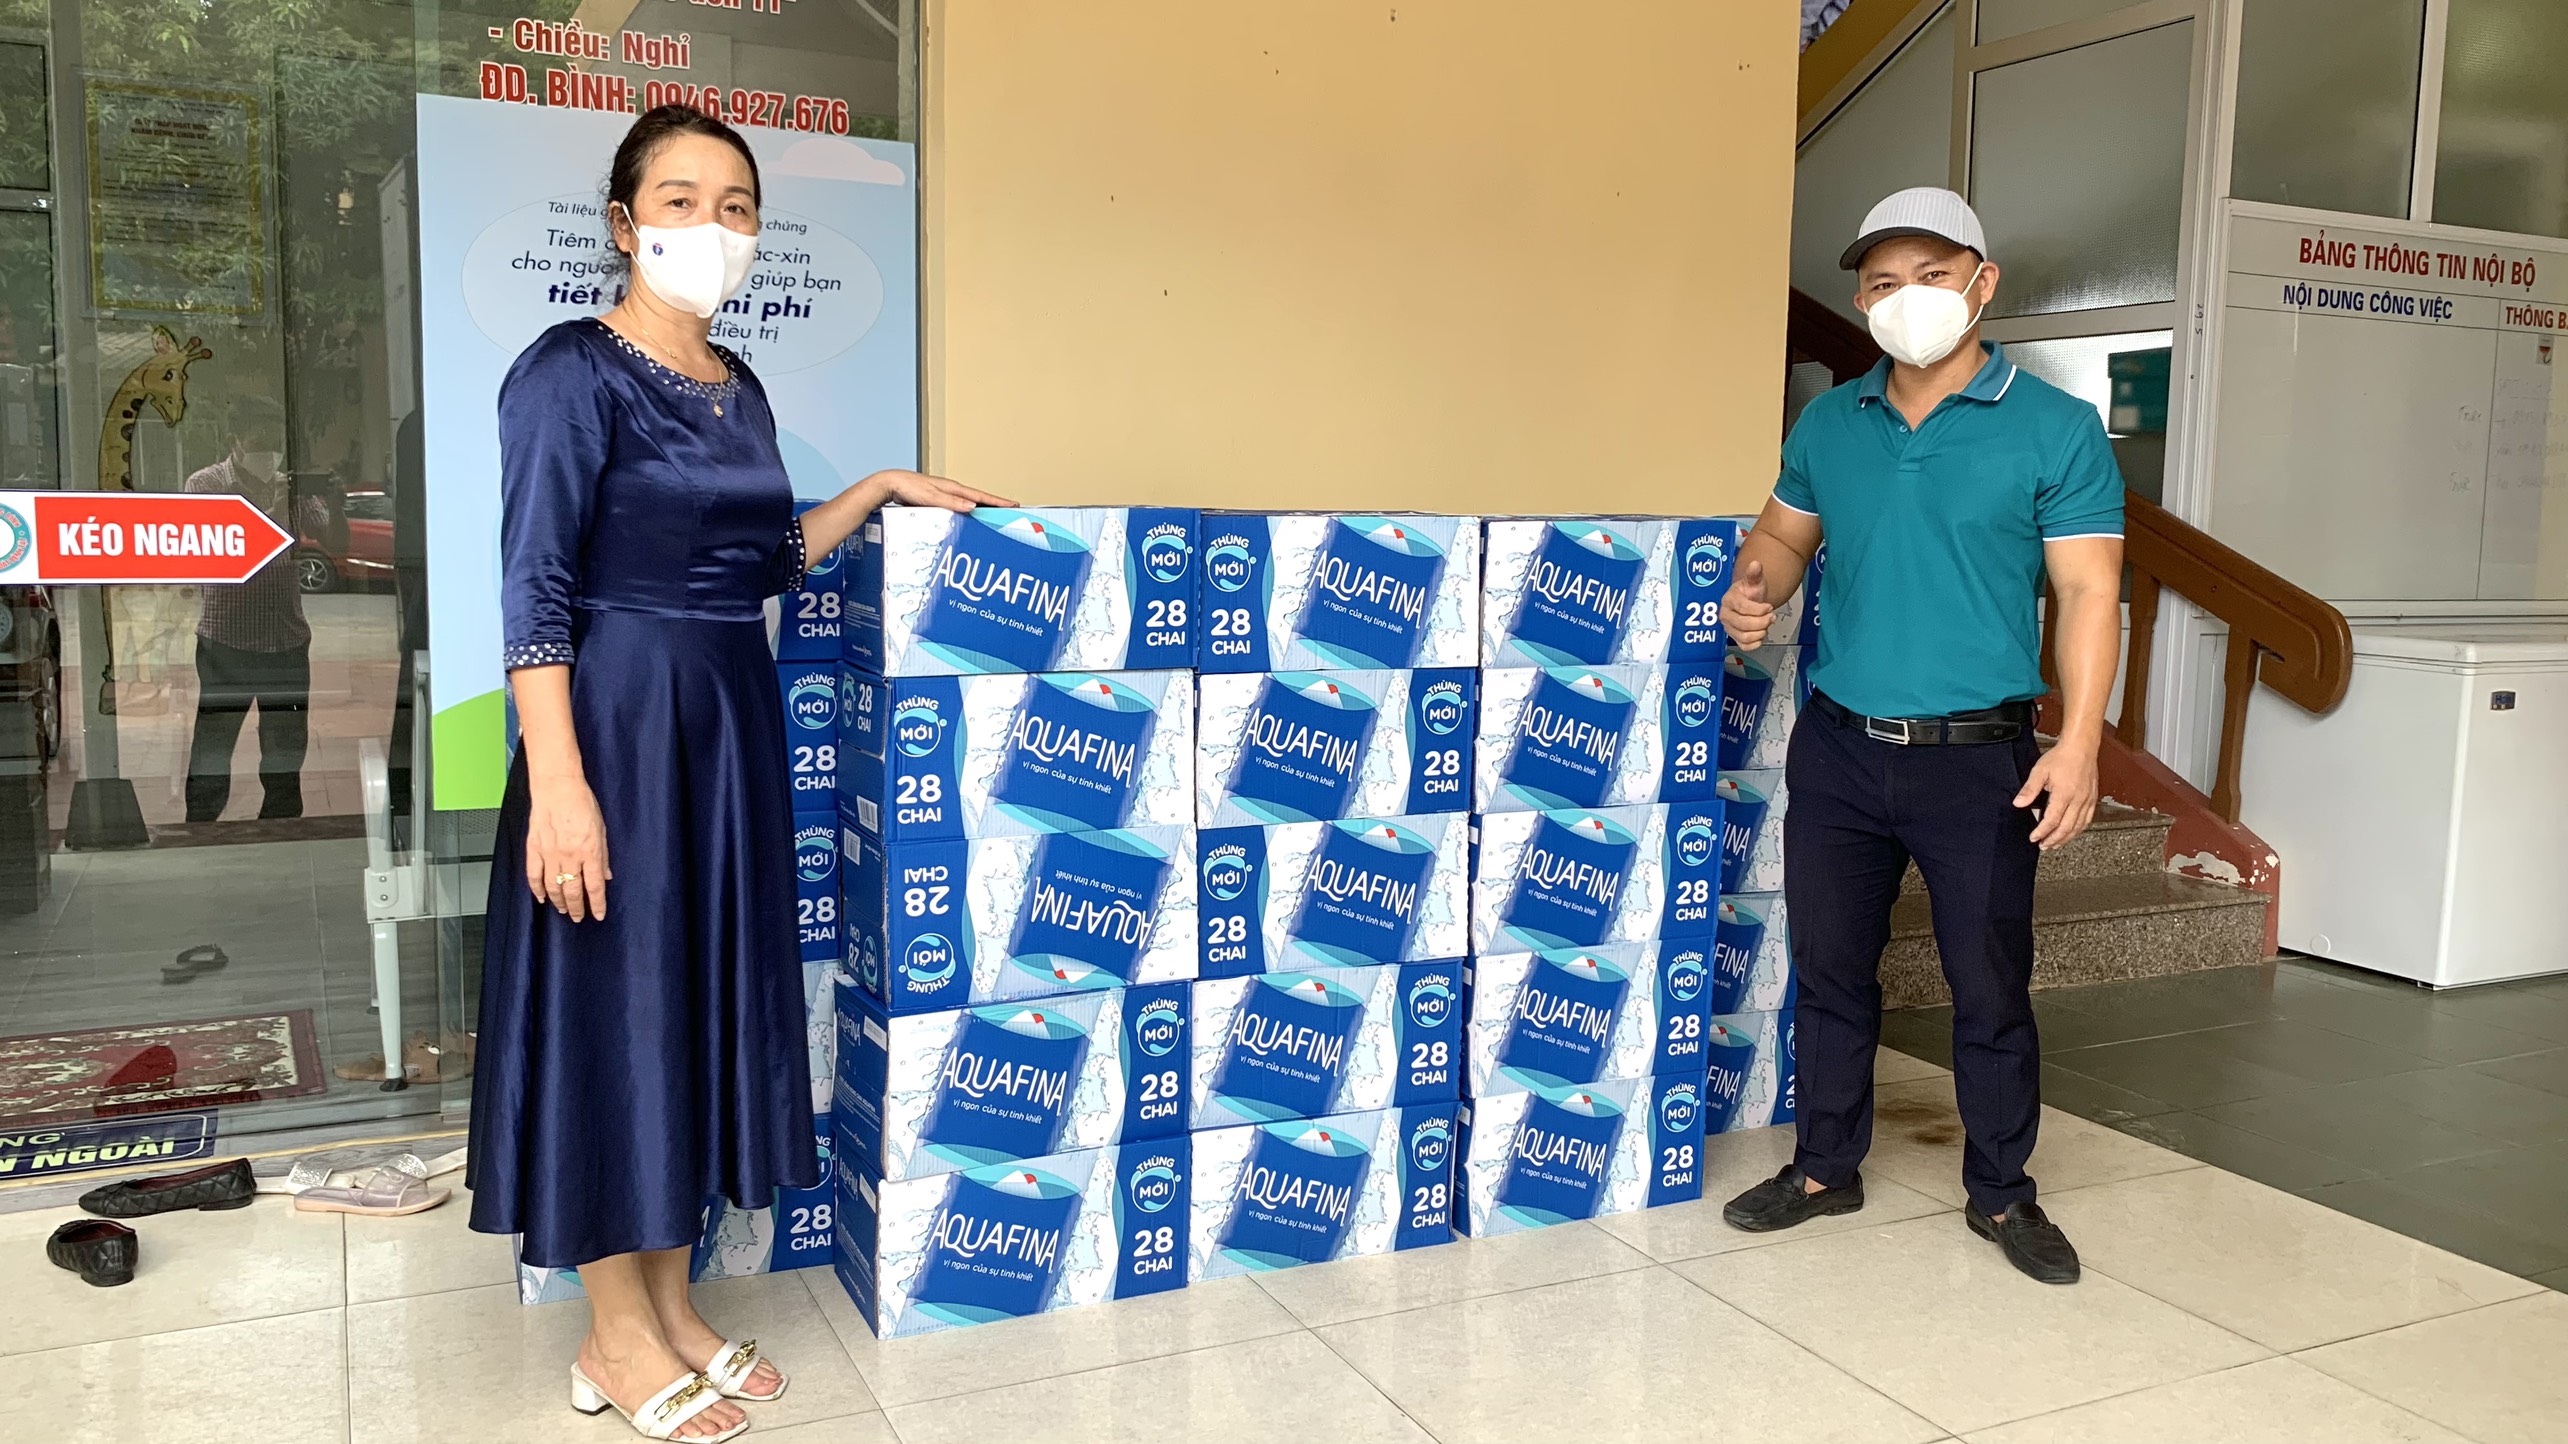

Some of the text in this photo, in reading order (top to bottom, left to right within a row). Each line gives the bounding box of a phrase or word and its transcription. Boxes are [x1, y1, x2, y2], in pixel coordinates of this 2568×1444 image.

[513, 19, 610, 60] Chiều:
[622, 34, 690, 69] Nghỉ
[480, 62, 537, 106] ĐD.
[547, 64, 636, 114] BÌNH:
[548, 201, 569, 214] Tài
[572, 203, 597, 218] liệu
[547, 229, 596, 249] Tiêm
[511, 250, 552, 271] cho
[2299, 230, 2536, 292] BẢNG THÔNG TIN NỘI BỘ
[751, 270, 841, 292] giúp bạn
[549, 282, 602, 305] tiết
[2283, 282, 2453, 322] NỘI DUNG CÔNG VIỆC
[761, 295, 813, 322] phí
[2506, 304, 2568, 330] THÔNG B
[708, 318, 779, 343] điều trị
[58, 516, 124, 557] KÉO
[134, 523, 245, 557] NGANG
[1147, 521, 1186, 540] THÙNG
[1210, 532, 1249, 549] THÙNG
[1691, 533, 1723, 549] THÙNG
[1151, 550, 1181, 567] MỚI
[1693, 559, 1716, 573] MỚI
[1214, 560, 1244, 576] MỚI
[929, 545, 1071, 631] AQUAFINA
[1309, 550, 1426, 630] AQUAFINA
[1523, 555, 1627, 629] AQUAFINA
[798, 592, 841, 619] 28
[1146, 600, 1186, 628] 28
[1684, 602, 1718, 627] 28
[957, 602, 977, 614] ngon
[980, 610, 995, 620] của
[997, 616, 1008, 625] sự
[1009, 619, 1024, 630] tinh
[1210, 609, 1250, 636] 28
[798, 623, 840, 638] CHAI
[1146, 631, 1185, 646] CHAI
[1684, 630, 1716, 643] CHAI
[1212, 640, 1250, 655] CHAI
[795, 672, 836, 688] THÙNG
[1427, 680, 1462, 695] THÙNG
[1680, 675, 1712, 688] THÙNG
[798, 699, 829, 714] MỚI
[858, 683, 872, 713] 28
[895, 694, 939, 712] THÙNG
[1682, 699, 1705, 713] MỚI
[1430, 705, 1456, 720] MỚI
[900, 724, 933, 741] MỚI
[1515, 701, 1618, 771] AQUAFINA
[1005, 709, 1136, 789] AQUAFINA
[1241, 708, 1358, 782] AQUAFINA
[1675, 742, 1708, 766] 28
[794, 745, 836, 773] 28
[1424, 750, 1460, 776] 28
[794, 776, 836, 790] CHAI
[1030, 764, 1049, 774] ngon
[1052, 769, 1066, 780] của
[1068, 775, 1078, 784] sự
[1079, 778, 1094, 788] tinh
[1675, 769, 1706, 782] CHAI
[896, 774, 942, 804] 28
[1424, 779, 1458, 794] CHAI
[897, 807, 941, 824] CHAI
[1681, 815, 1713, 828] THÙNG
[795, 825, 835, 839] THÙNG
[1208, 844, 1246, 860] THÙNG
[1683, 838, 1706, 852] MỚI
[799, 852, 829, 867] MỚI
[904, 866, 948, 883] CHAI
[1212, 870, 1240, 886] MỚI
[1516, 844, 1619, 911] AQUAFINA
[1302, 854, 1416, 924] AQUAFINA
[1675, 880, 1709, 905] 28
[798, 896, 836, 925] 28
[904, 886, 950, 917] 28
[1031, 875, 1159, 950] AQUAFINA
[1676, 907, 1707, 921] CHAI
[799, 926, 836, 943] CHAI
[1208, 916, 1246, 944] 28
[913, 949, 946, 966] MỚI
[1208, 946, 1246, 962] CHAI
[1673, 950, 1703, 964] THÙNG
[907, 976, 950, 994] THÙNG
[1415, 973, 1450, 988] THÙNG
[1674, 974, 1697, 988] MỚI
[1141, 997, 1178, 1015] THÙNG
[1417, 998, 1444, 1013] MỚI
[1510, 984, 1611, 1048] AQUAFINA
[1145, 1026, 1173, 1041] MỚI
[1668, 1015, 1700, 1040] 28
[1225, 1008, 1344, 1077] AQUAFINA
[1668, 1042, 1698, 1056] CHAI
[1410, 1042, 1448, 1068] 28
[936, 1047, 1068, 1117] AQUAFINA
[1139, 1071, 1179, 1102] 28
[1411, 1070, 1447, 1086] CHAI
[1666, 1082, 1696, 1097] THÙNG
[1140, 1101, 1177, 1120] CHAI
[1667, 1106, 1691, 1120] MỚI
[1416, 1117, 1449, 1134] THÙNG
[31, 1136, 175, 1169] NGOÀI
[1419, 1142, 1442, 1158] MỚI
[1509, 1123, 1607, 1183] AQUAFINA
[1663, 1145, 1694, 1171] 28
[1137, 1156, 1175, 1172] THÙNG
[1663, 1173, 1692, 1187] CHAI
[1139, 1183, 1168, 1198] MỚI
[1234, 1162, 1352, 1227] AQUAFINA
[1412, 1184, 1446, 1212] 28
[790, 1204, 832, 1234] 28
[1412, 1212, 1445, 1228] CHAI
[791, 1234, 831, 1250] CHAI
[927, 1208, 1059, 1274] AQUAFINA
[1133, 1227, 1174, 1257] 28
[951, 1261, 970, 1270] ngon
[973, 1264, 987, 1273] của
[989, 1268, 999, 1276] sự
[1001, 1269, 1015, 1278] tinh
[1134, 1257, 1173, 1275] CHAI
